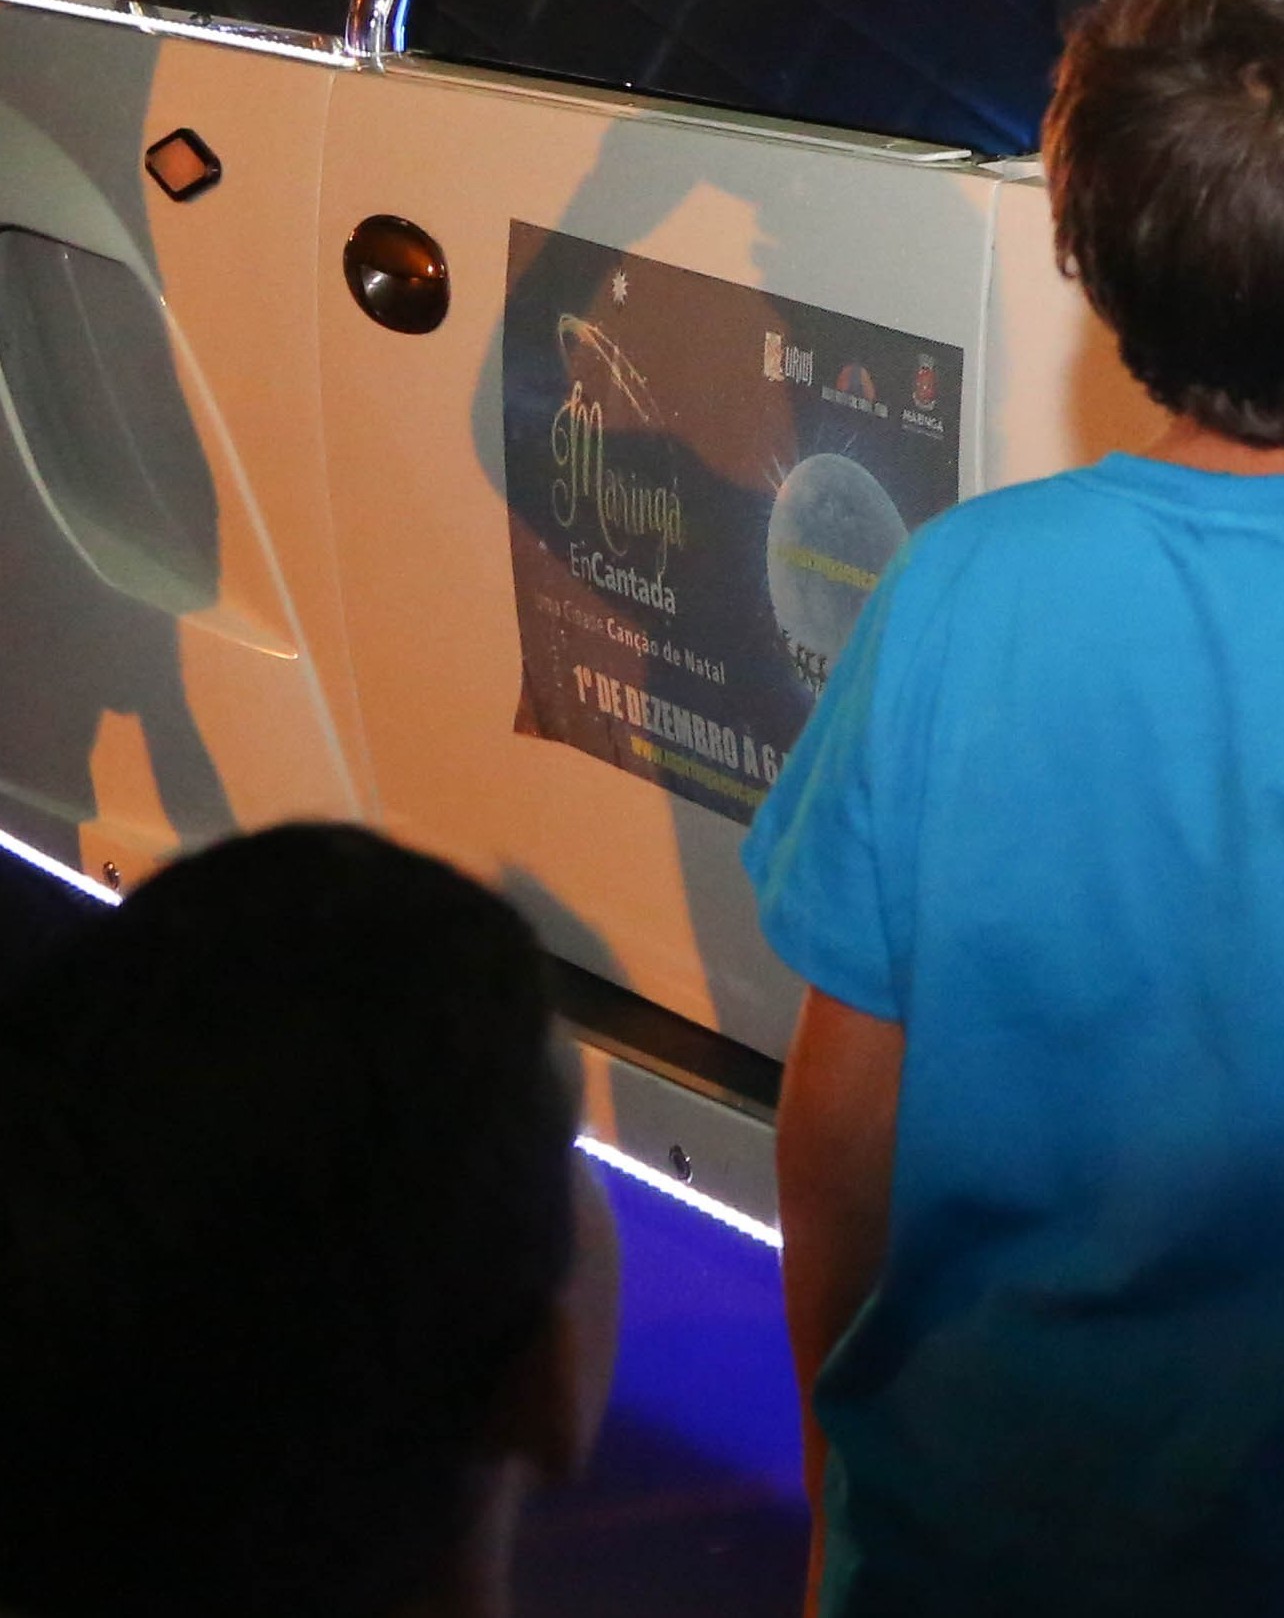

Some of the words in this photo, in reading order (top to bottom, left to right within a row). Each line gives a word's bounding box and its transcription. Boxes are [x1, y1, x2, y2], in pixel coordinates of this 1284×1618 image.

[569, 542, 676, 616] EnCantada
[607, 617, 659, 658] Canção
[663, 640, 681, 666] de
[684, 647, 726, 685] Natal
[595, 671, 624, 720] DE
[626, 684, 739, 770] DEZEMBRO
